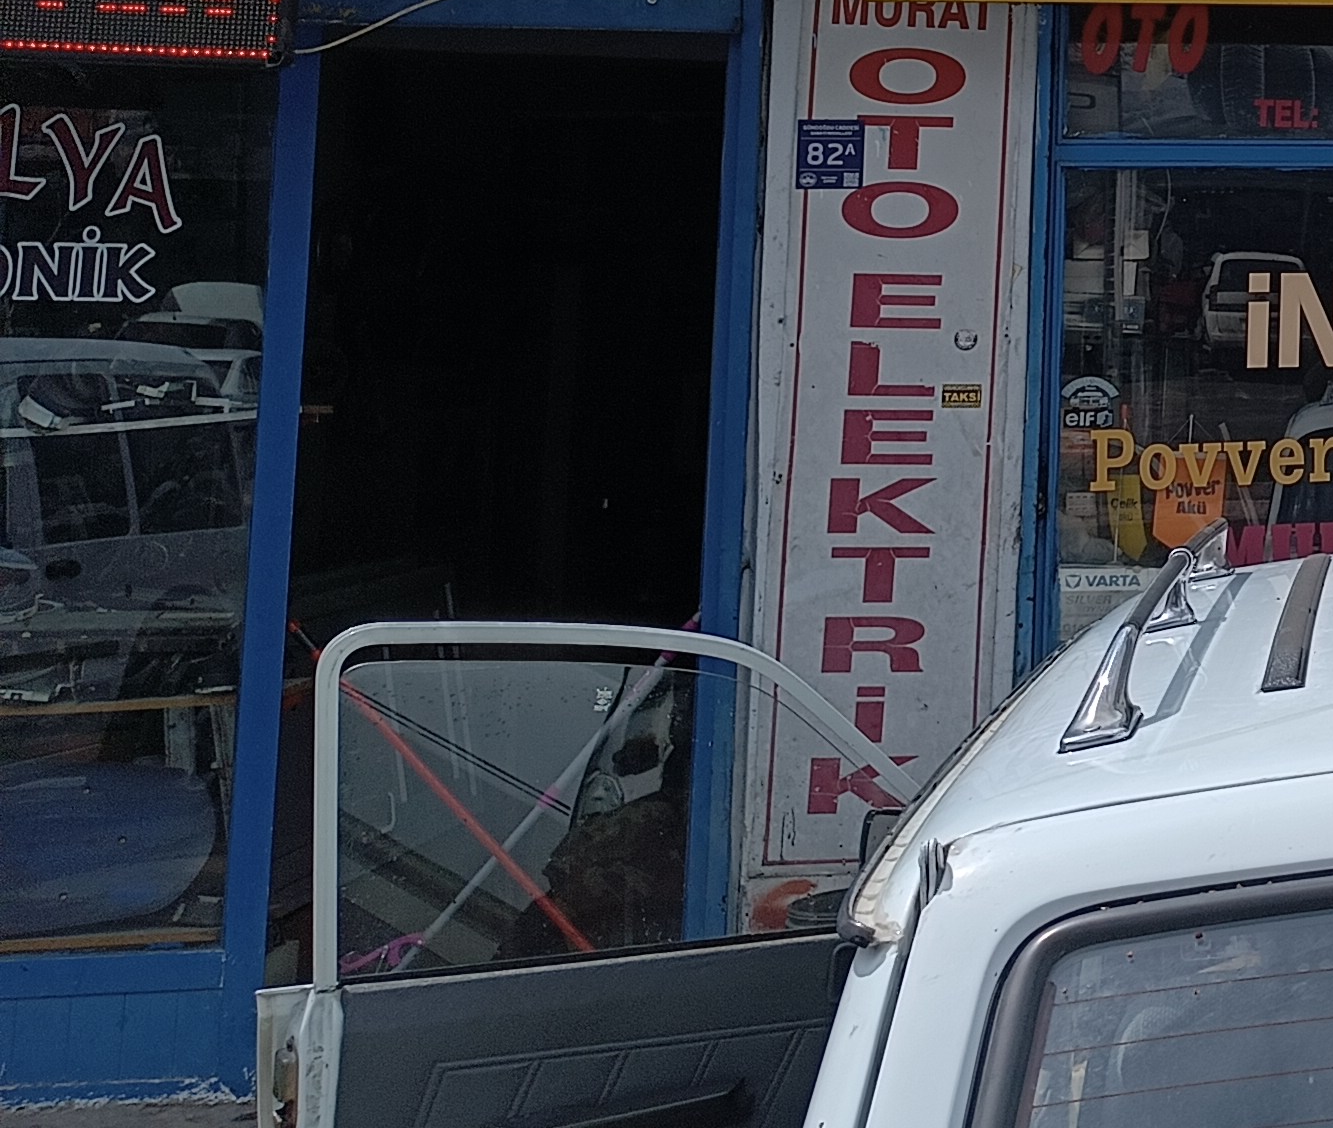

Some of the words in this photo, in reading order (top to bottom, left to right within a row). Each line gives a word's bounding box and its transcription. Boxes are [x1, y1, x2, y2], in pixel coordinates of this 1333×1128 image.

[1081, 4, 1209, 75] OTO
[1254, 98, 1319, 129] TEL:
[0, 103, 182, 234] LYA
[0, 225, 156, 303] NİK
[1065, 411, 1095, 427] elf
[1086, 574, 1142, 588] VARTA
